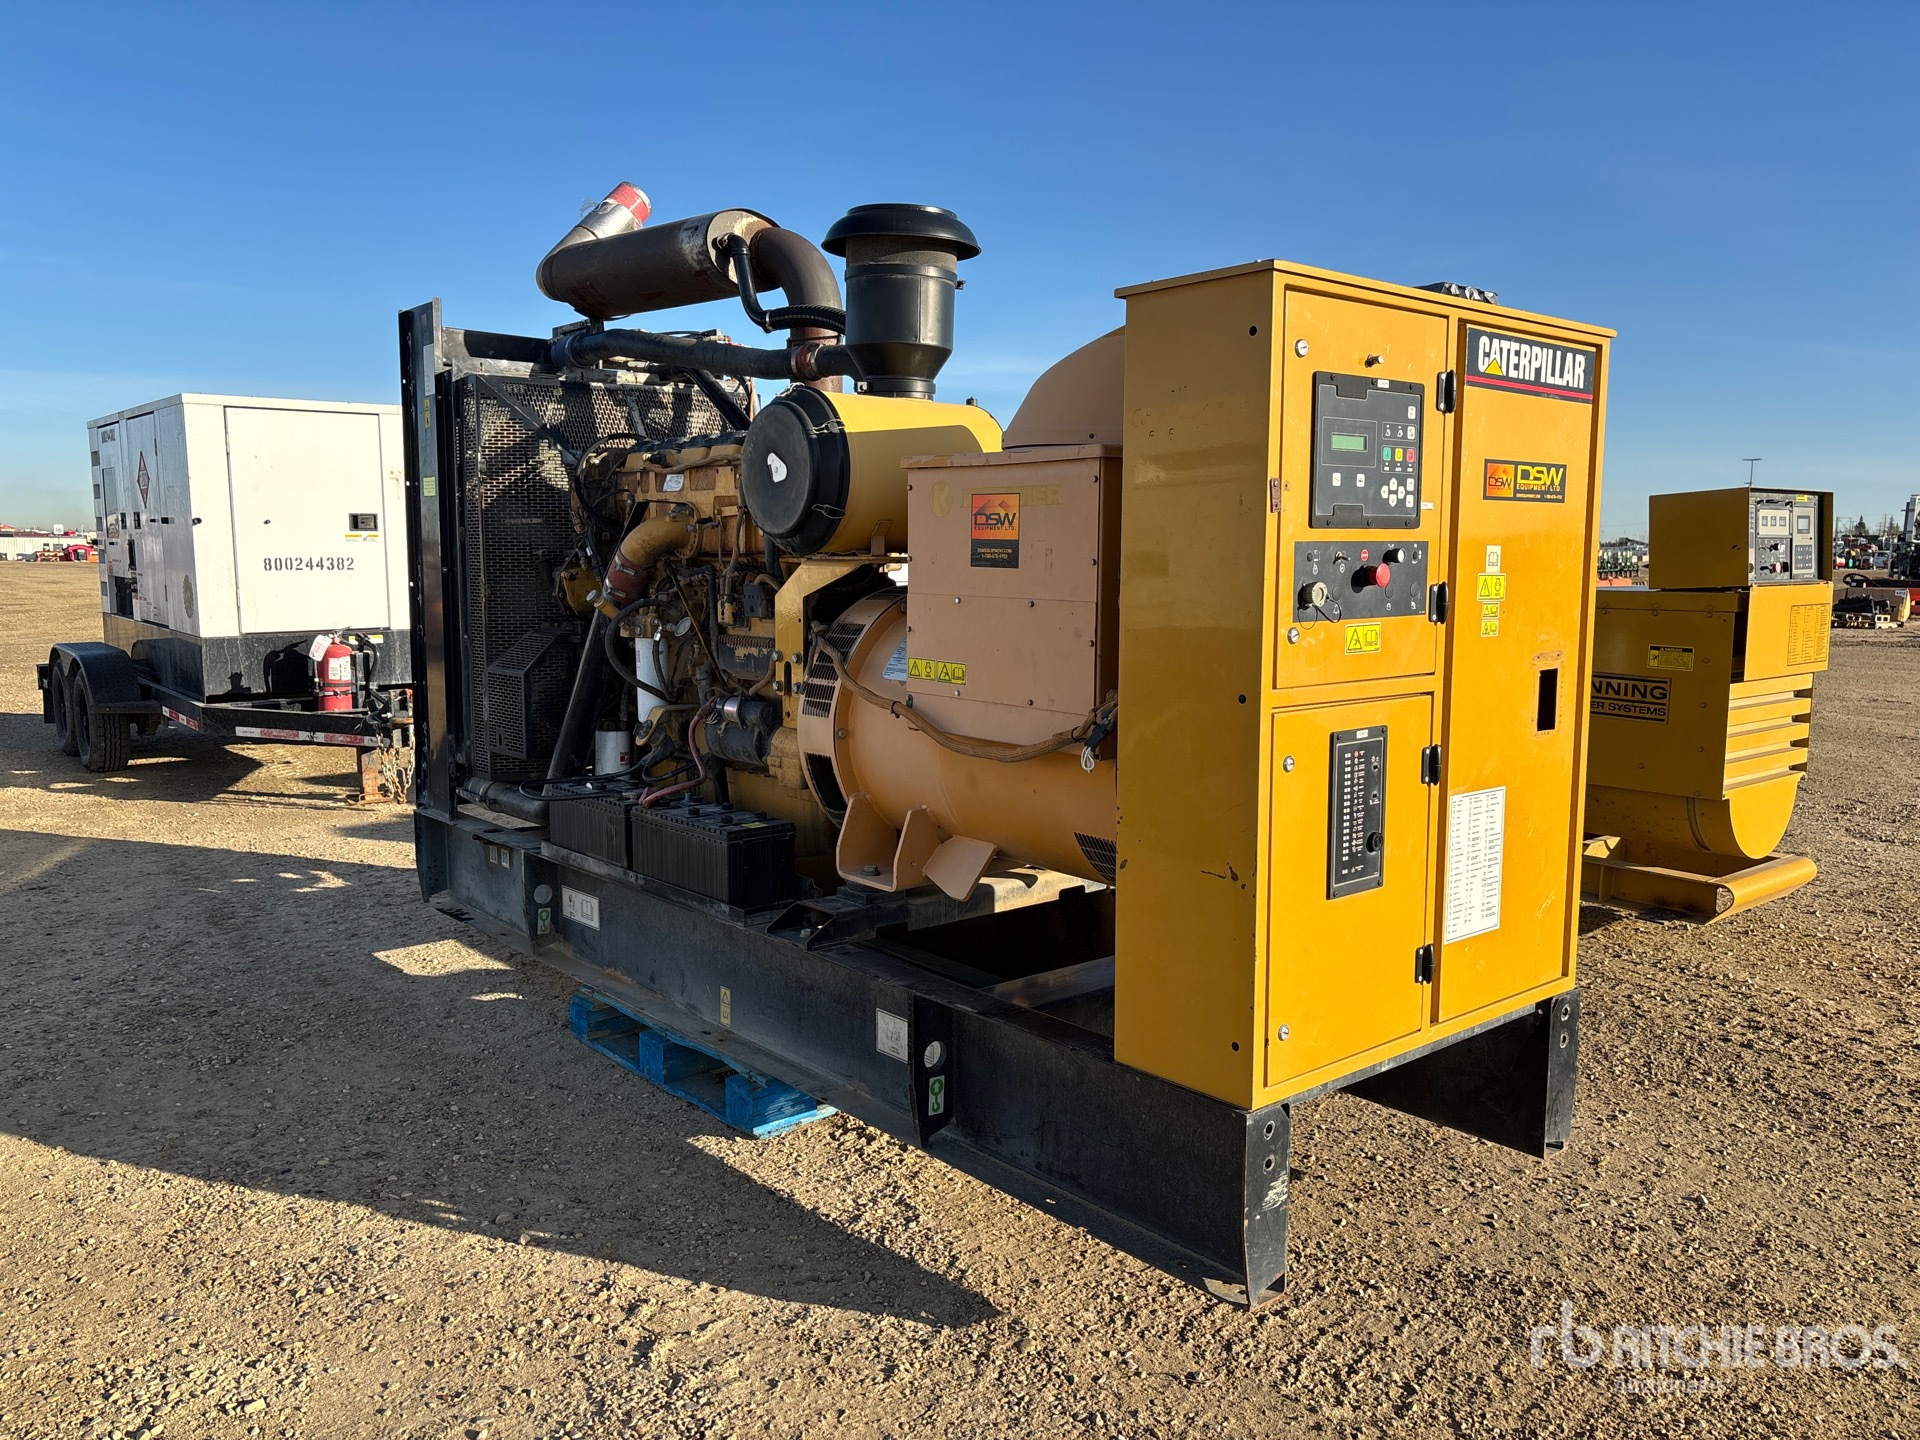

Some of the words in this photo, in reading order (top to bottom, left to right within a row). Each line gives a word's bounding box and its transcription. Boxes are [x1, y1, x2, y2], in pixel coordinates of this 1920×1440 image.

[1477, 335, 1586, 389] CATERPILLAR
[1488, 476, 1513, 488] DSW
[1517, 465, 1564, 485] DSW
[974, 512, 1017, 526] DSW
[263, 557, 355, 571] 800244382
[1608, 702, 1667, 717] SYSTEMS
